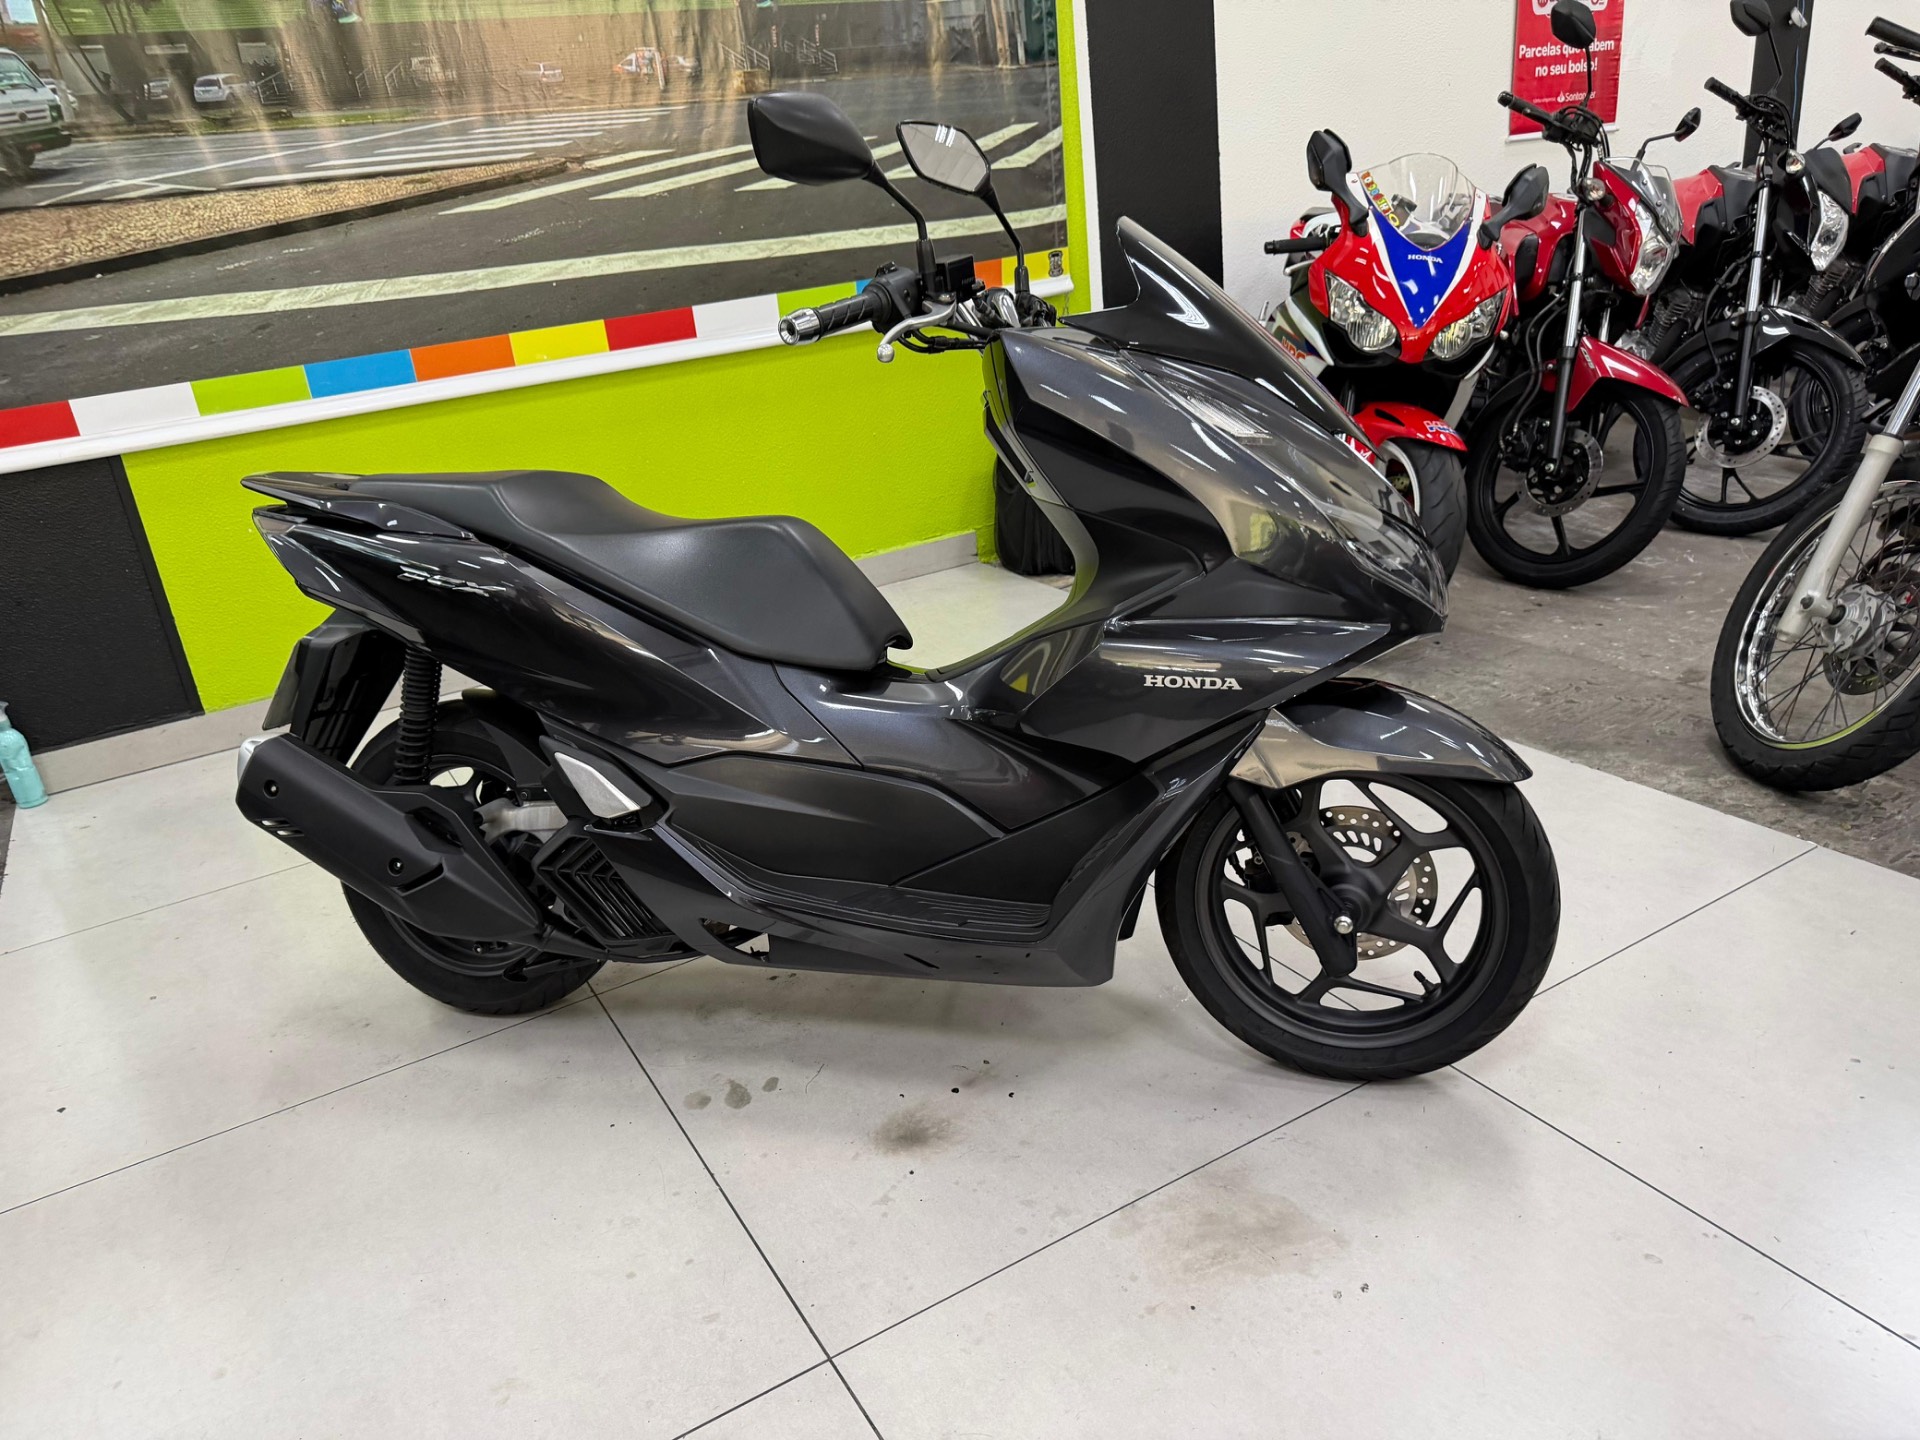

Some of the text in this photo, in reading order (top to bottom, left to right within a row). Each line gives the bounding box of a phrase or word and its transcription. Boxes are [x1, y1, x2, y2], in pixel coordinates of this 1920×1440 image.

[1519, 42, 1561, 58] Parcelas
[1583, 38, 1614, 53] abem
[1535, 64, 1549, 77] no
[1549, 62, 1567, 75] seu
[1565, 91, 1596, 102] Santaner
[1407, 254, 1443, 264] HONDA
[1143, 674, 1243, 691] HONDA
